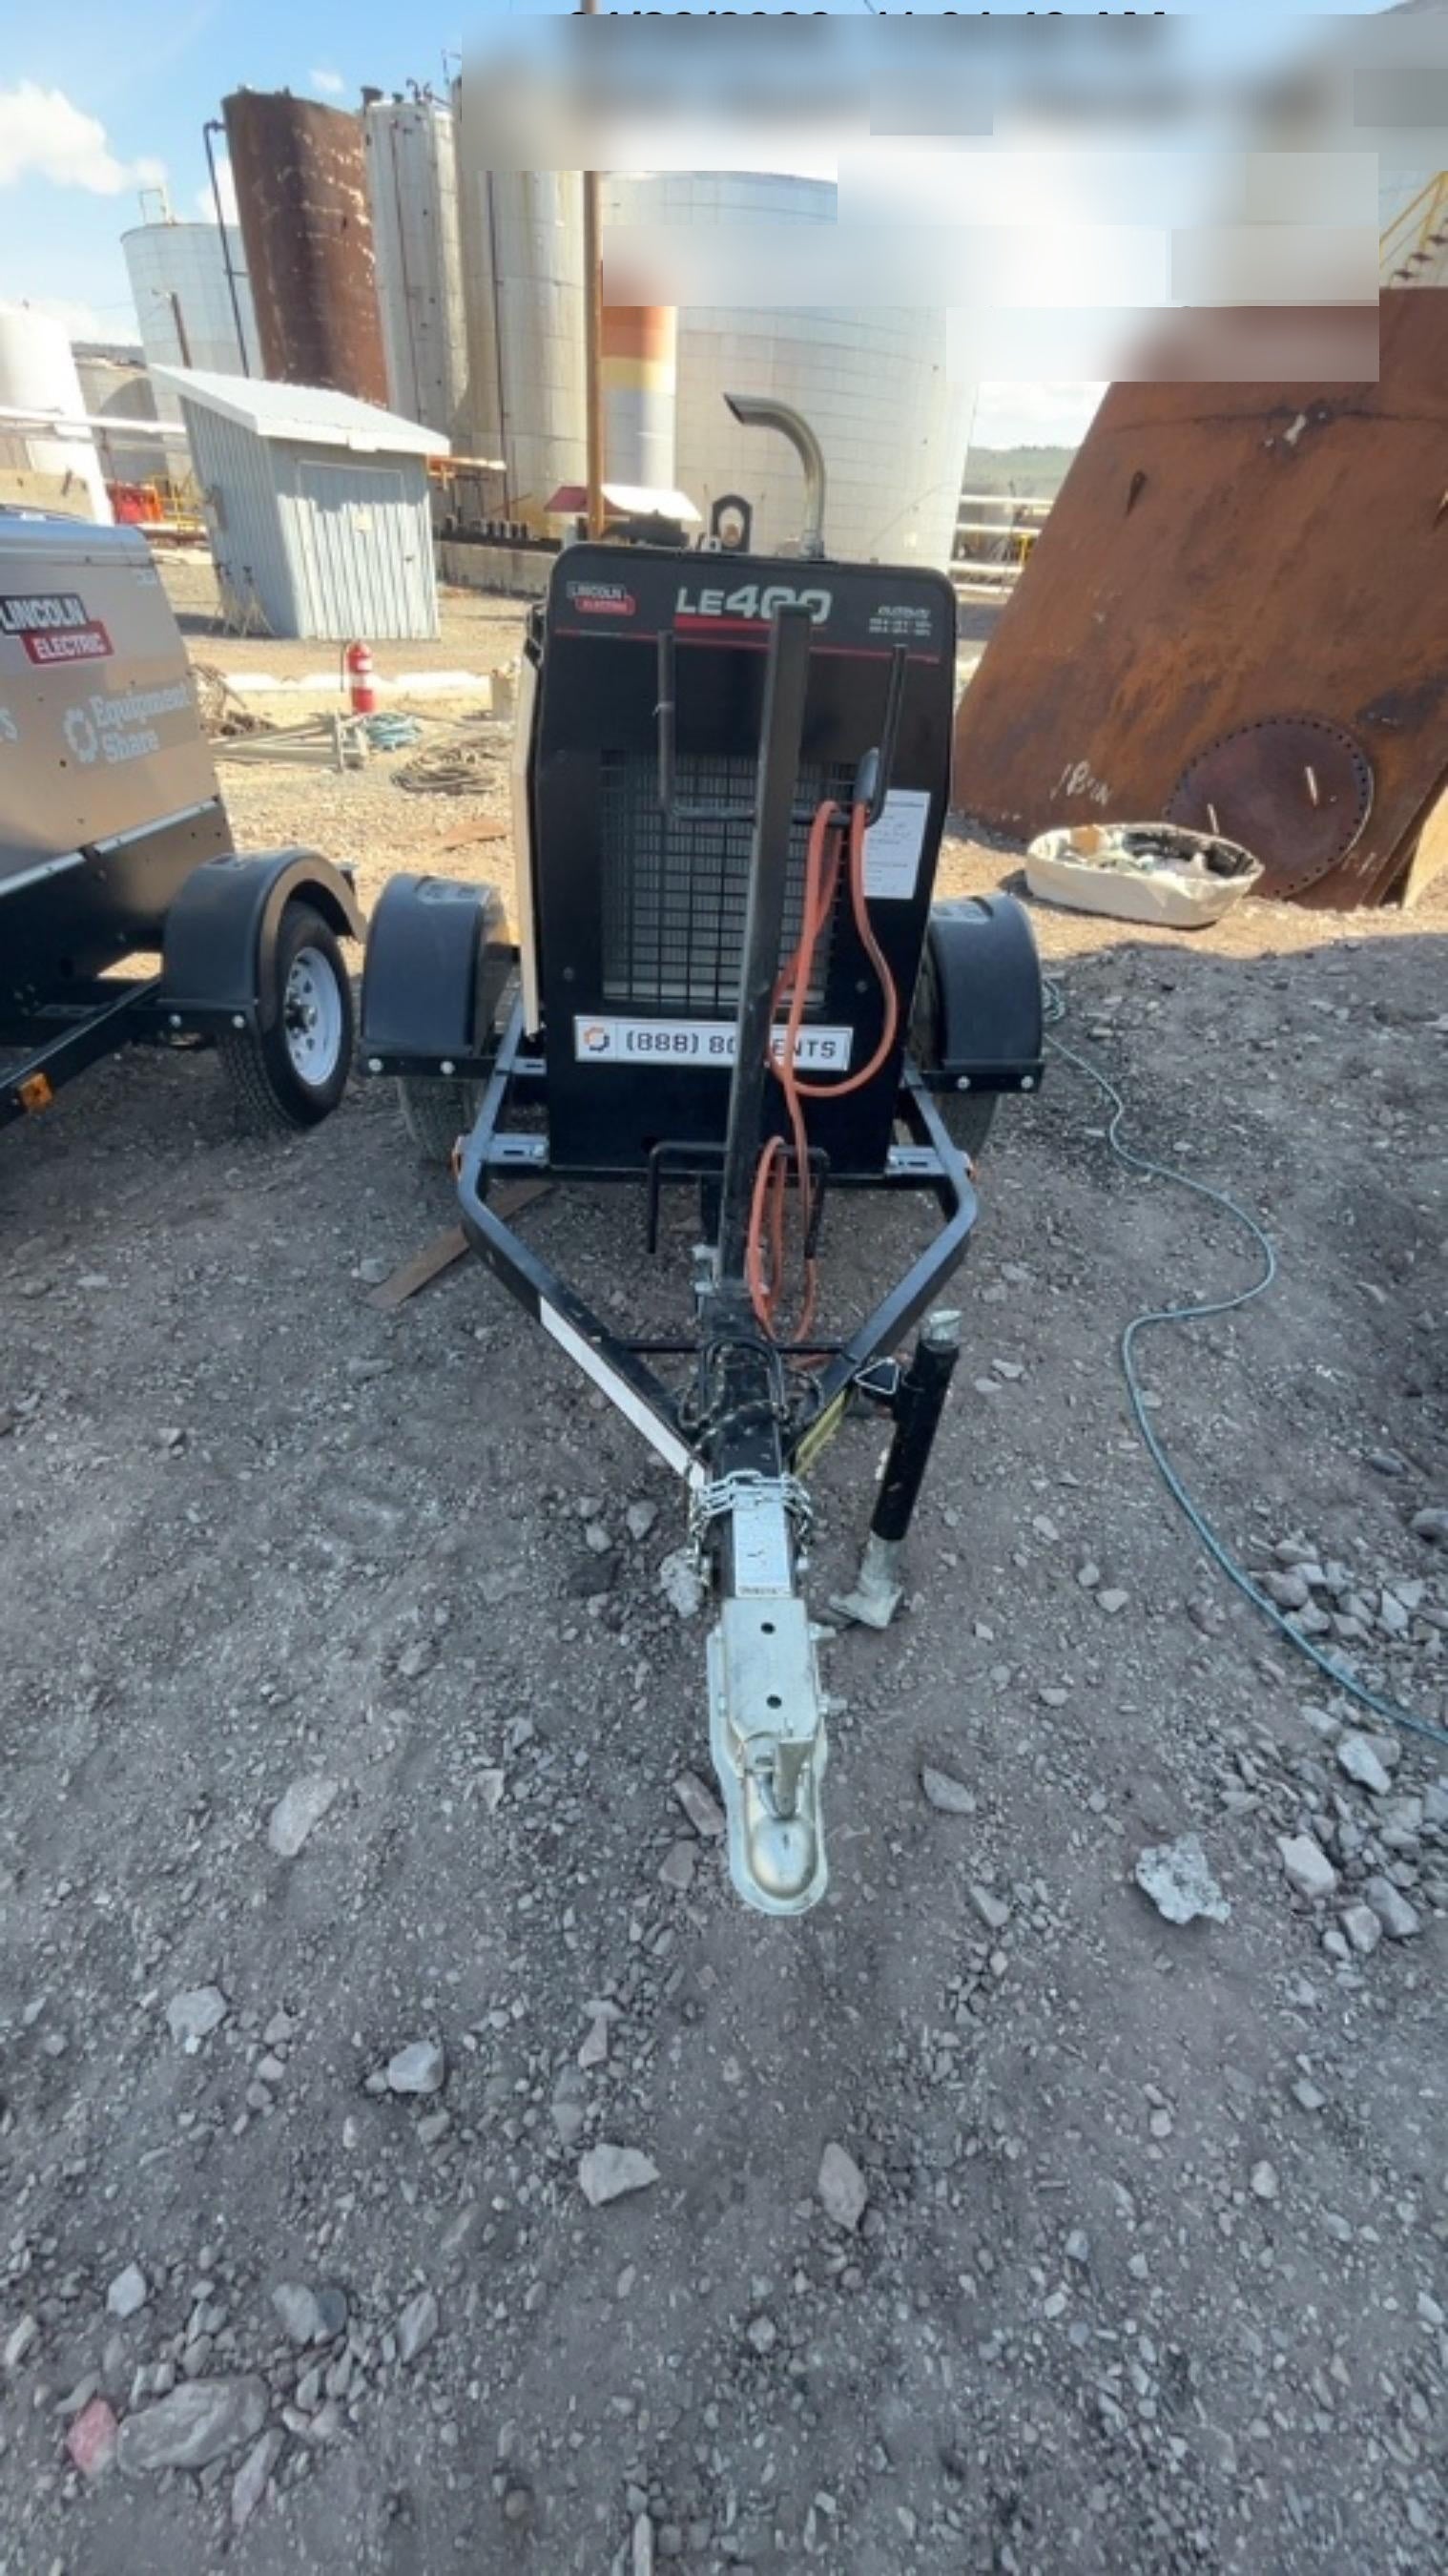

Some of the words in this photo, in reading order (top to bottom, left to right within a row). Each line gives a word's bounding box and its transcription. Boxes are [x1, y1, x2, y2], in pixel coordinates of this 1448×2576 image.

[0, 598, 86, 630] LINCOLN
[675, 584, 832, 624] LE400
[31, 634, 107, 659] ELECTRIC
[90, 681, 191, 730] Equipment
[102, 730, 160, 763] Share
[626, 1030, 698, 1054] (888)
